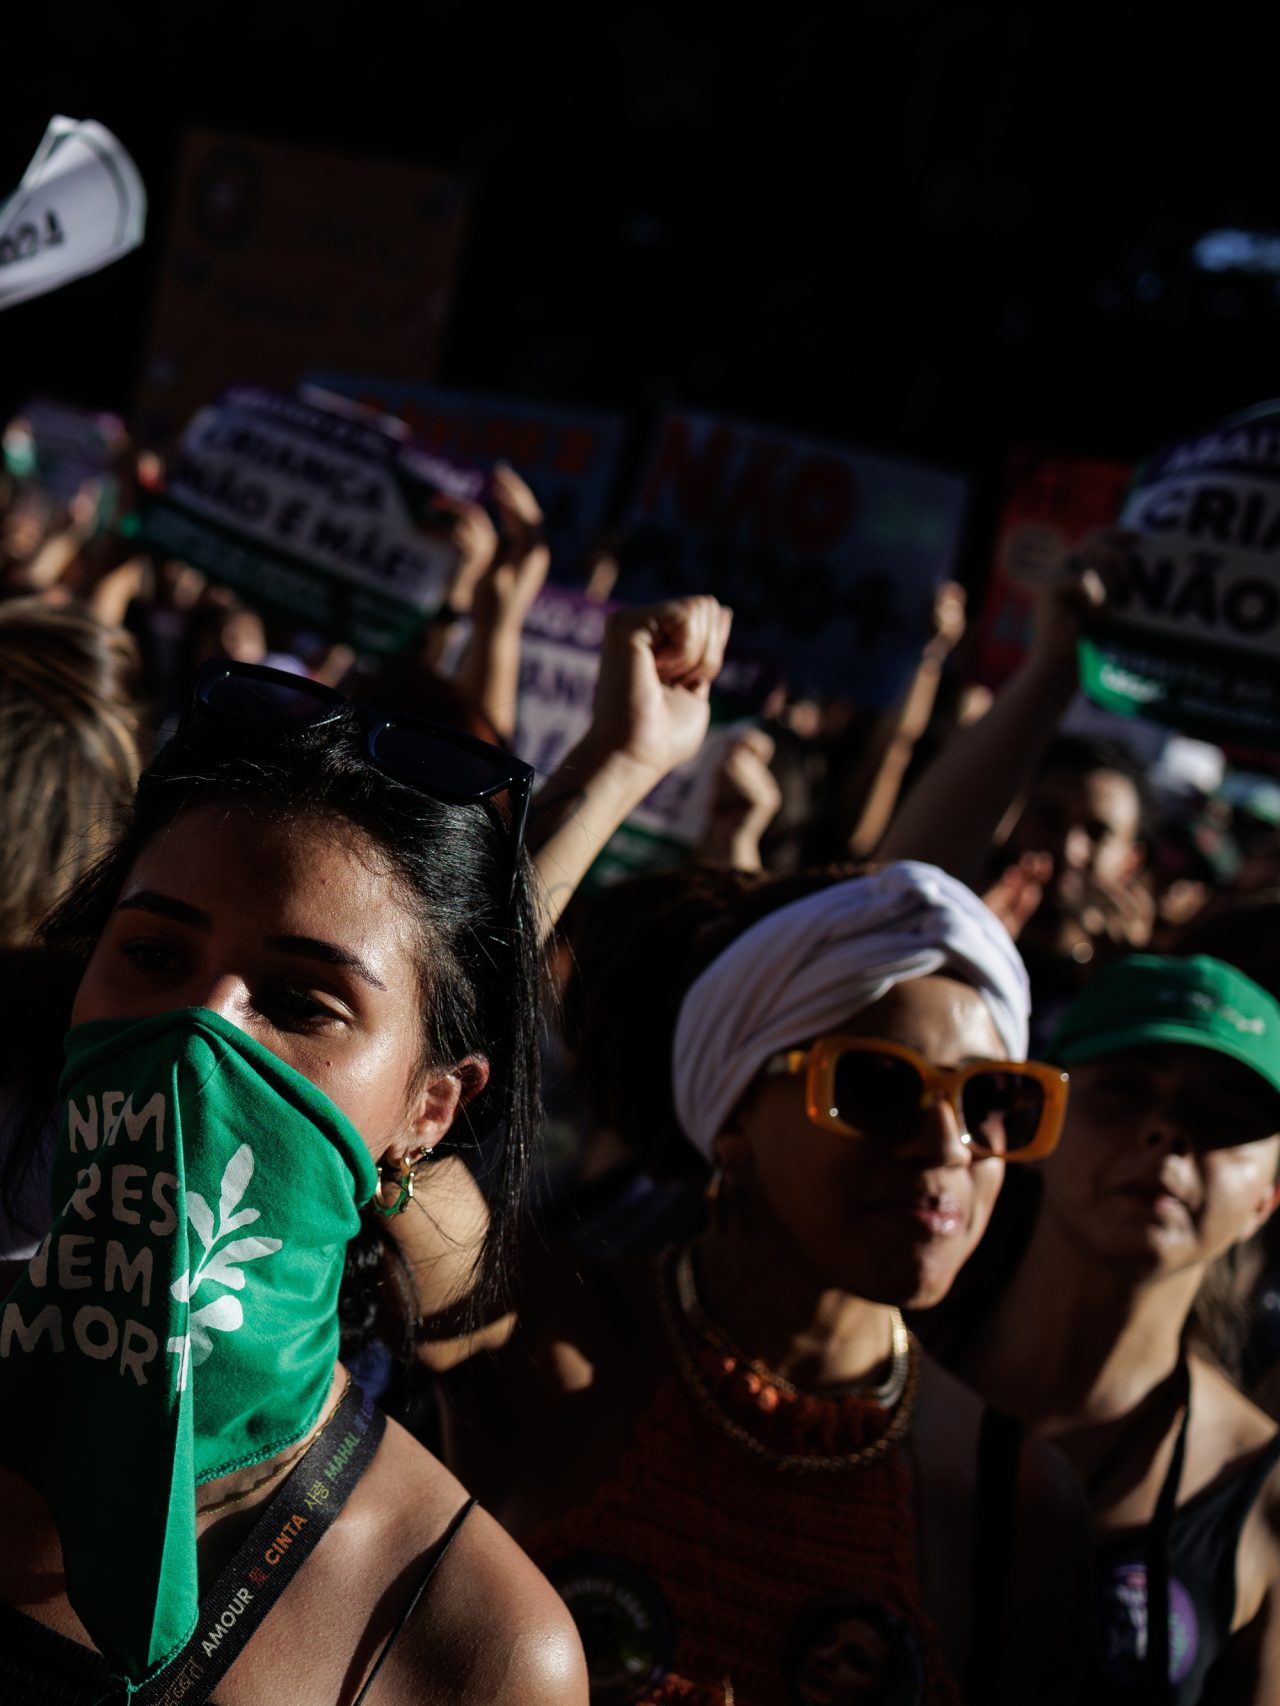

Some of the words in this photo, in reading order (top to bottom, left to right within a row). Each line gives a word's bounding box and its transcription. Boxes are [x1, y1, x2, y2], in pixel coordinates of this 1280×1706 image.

[1110, 552, 1278, 634] NÃO
[60, 1161, 181, 1238] RES
[324, 1432, 361, 1483] MAHAL
[201, 1586, 255, 1659] AMOUR
[263, 1512, 309, 1567] CINTA
